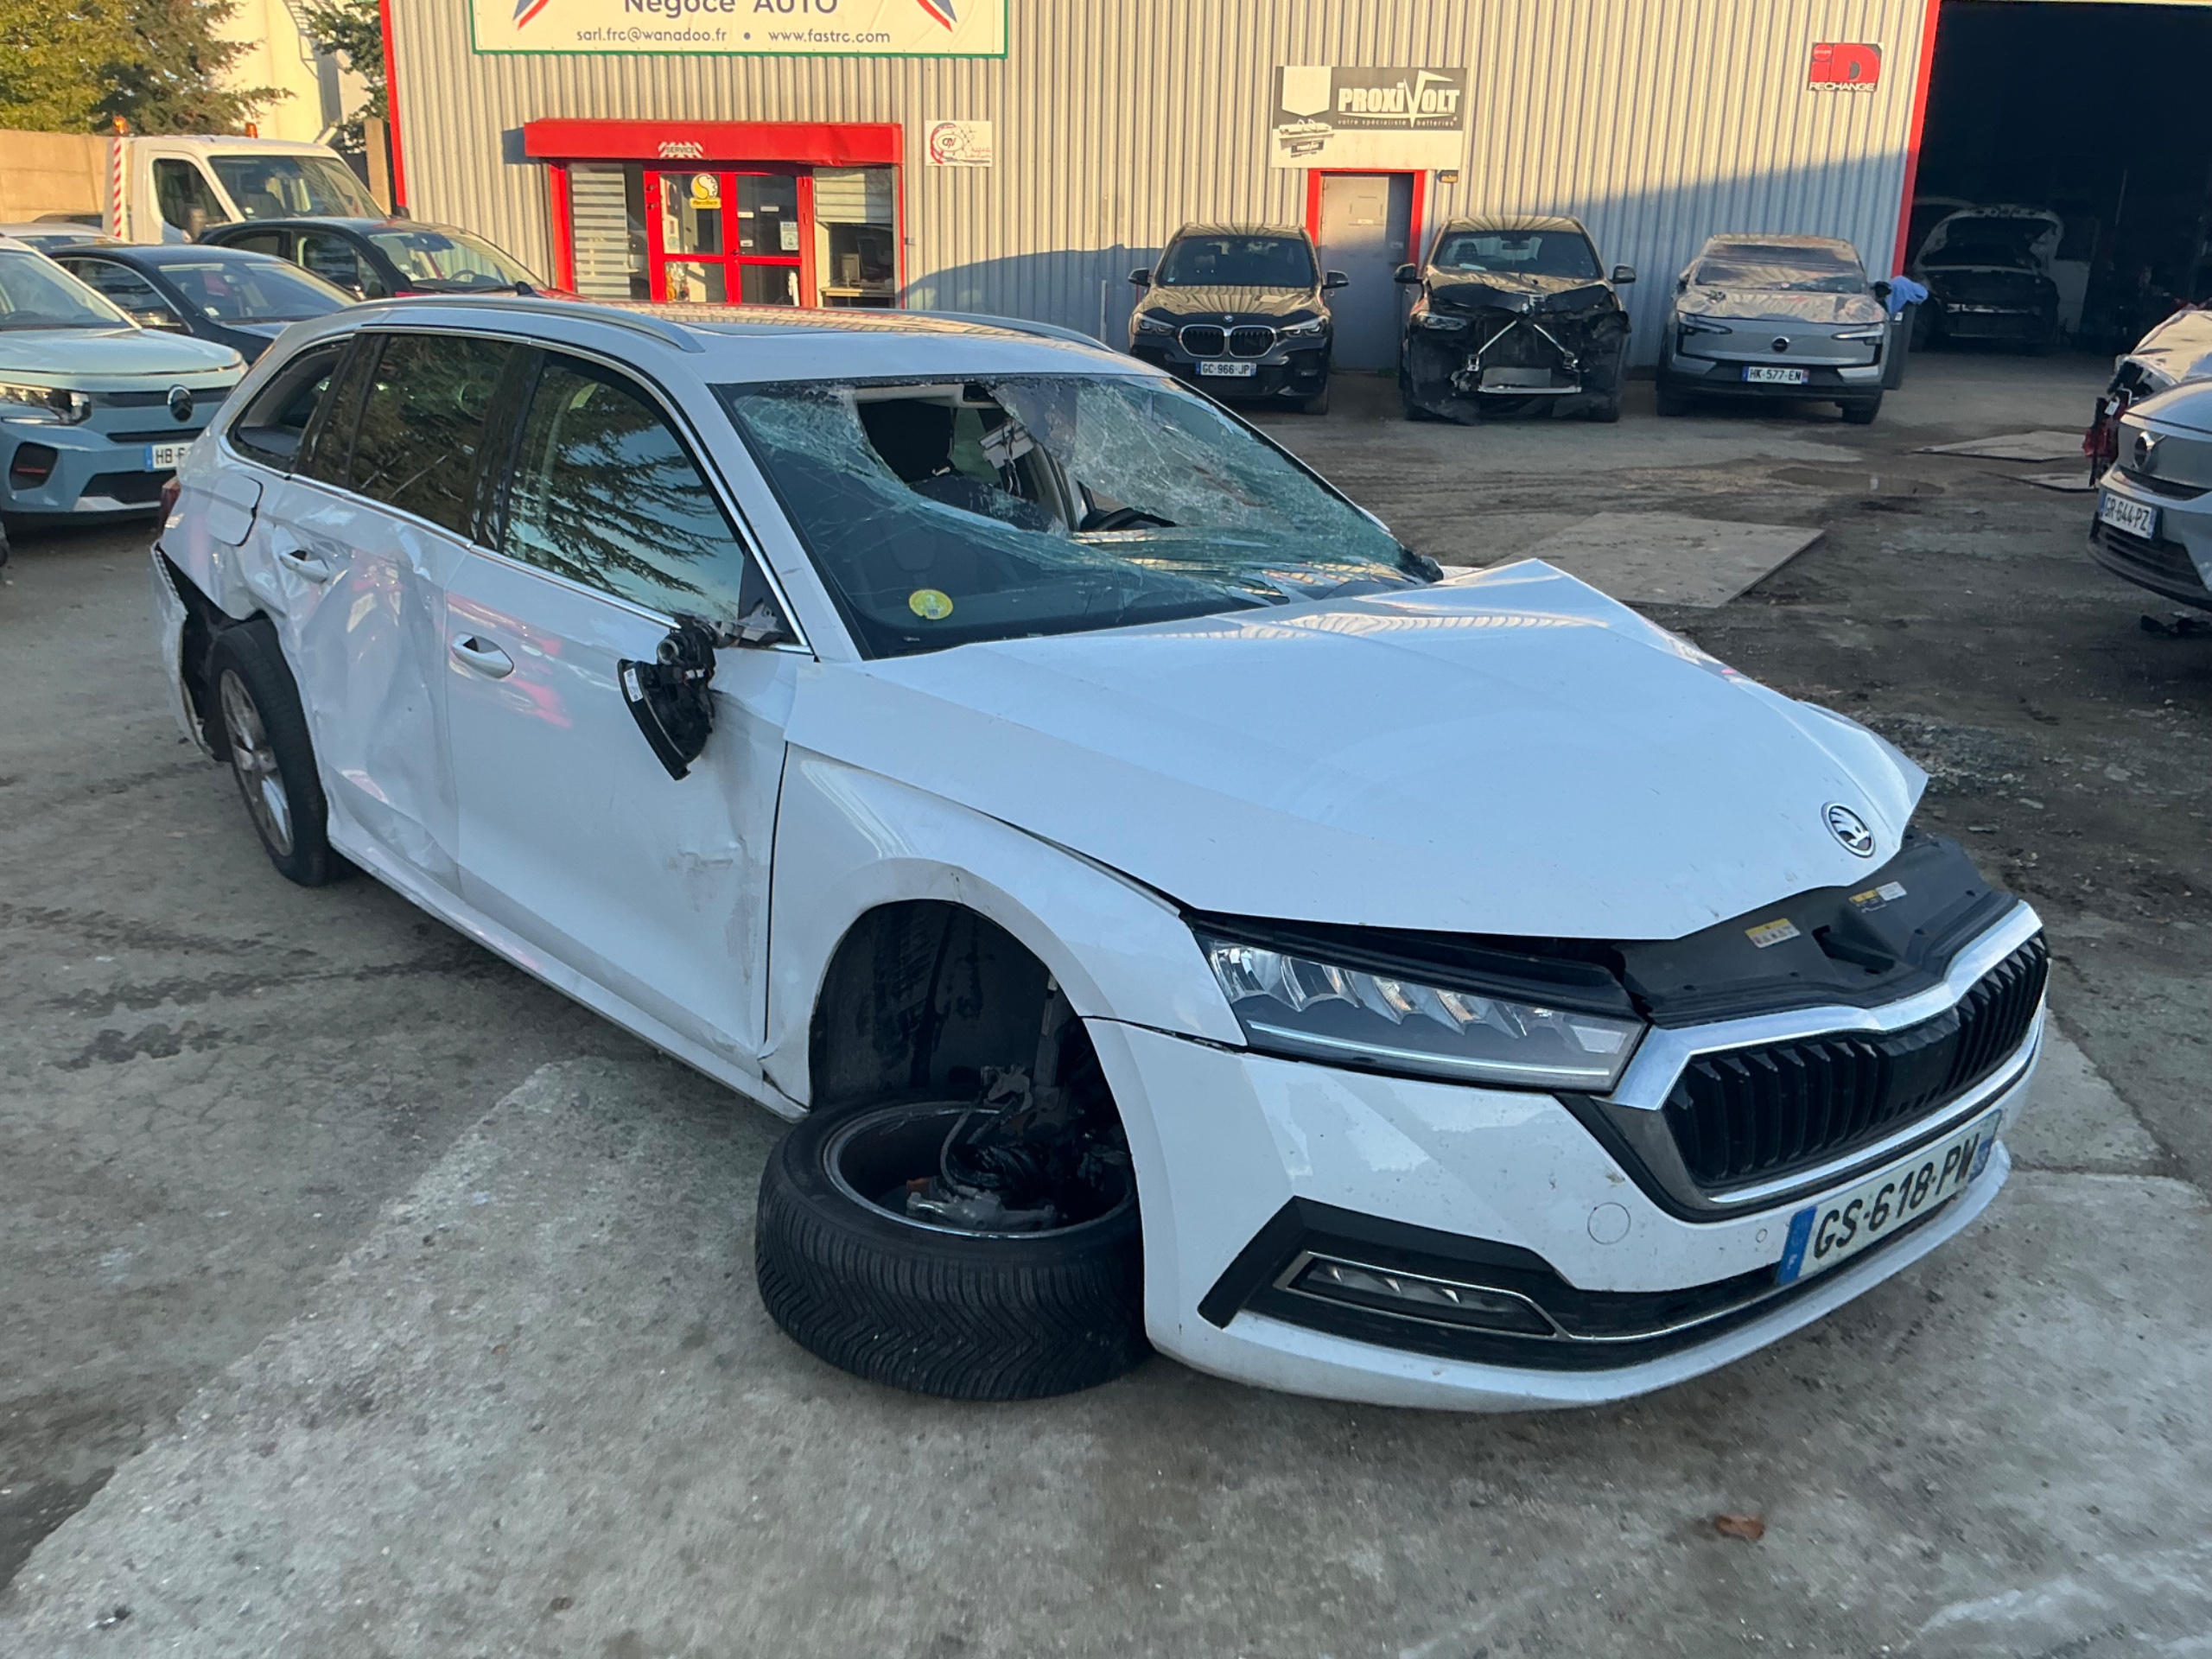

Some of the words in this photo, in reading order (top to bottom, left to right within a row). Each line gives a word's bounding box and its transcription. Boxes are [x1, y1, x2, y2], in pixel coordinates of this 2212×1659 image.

[576, 27, 727, 42] sarl.frc@wanadoo.fr
[768, 28, 891, 44] www.fastrc.com
[1808, 81, 1876, 92] RECHANGE
[1416, 118, 1454, 127] batteries
[1202, 363, 1250, 375] GC-966-JP
[1749, 368, 1802, 382] HK-577-EN
